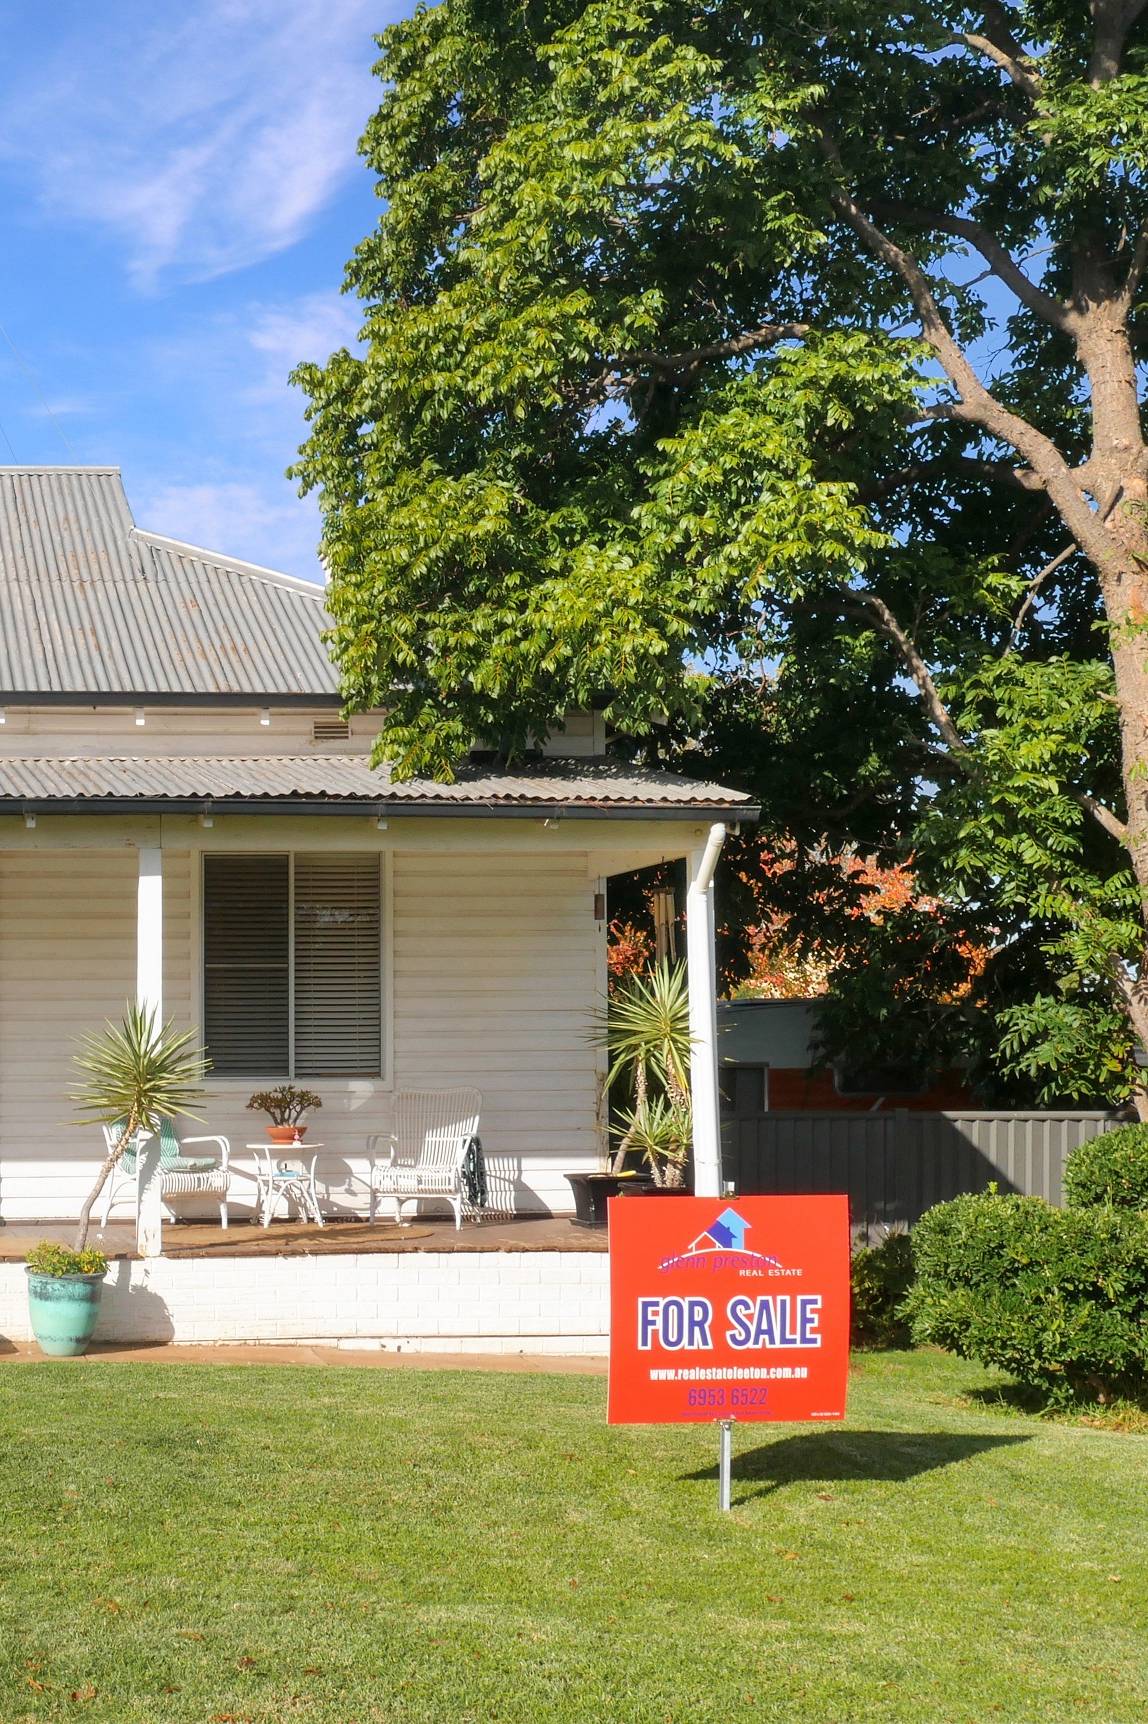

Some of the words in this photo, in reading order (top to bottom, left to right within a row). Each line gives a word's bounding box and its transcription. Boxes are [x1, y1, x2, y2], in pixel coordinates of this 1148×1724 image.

[739, 1269, 764, 1277] REAL
[768, 1269, 803, 1277] ESTATE
[638, 1297, 713, 1350] FOR
[726, 1295, 822, 1350] SALE
[650, 1366, 808, 1381] www.realestateleeton.com.au
[688, 1388, 726, 1406] 6953
[731, 1387, 768, 1405] 6522
